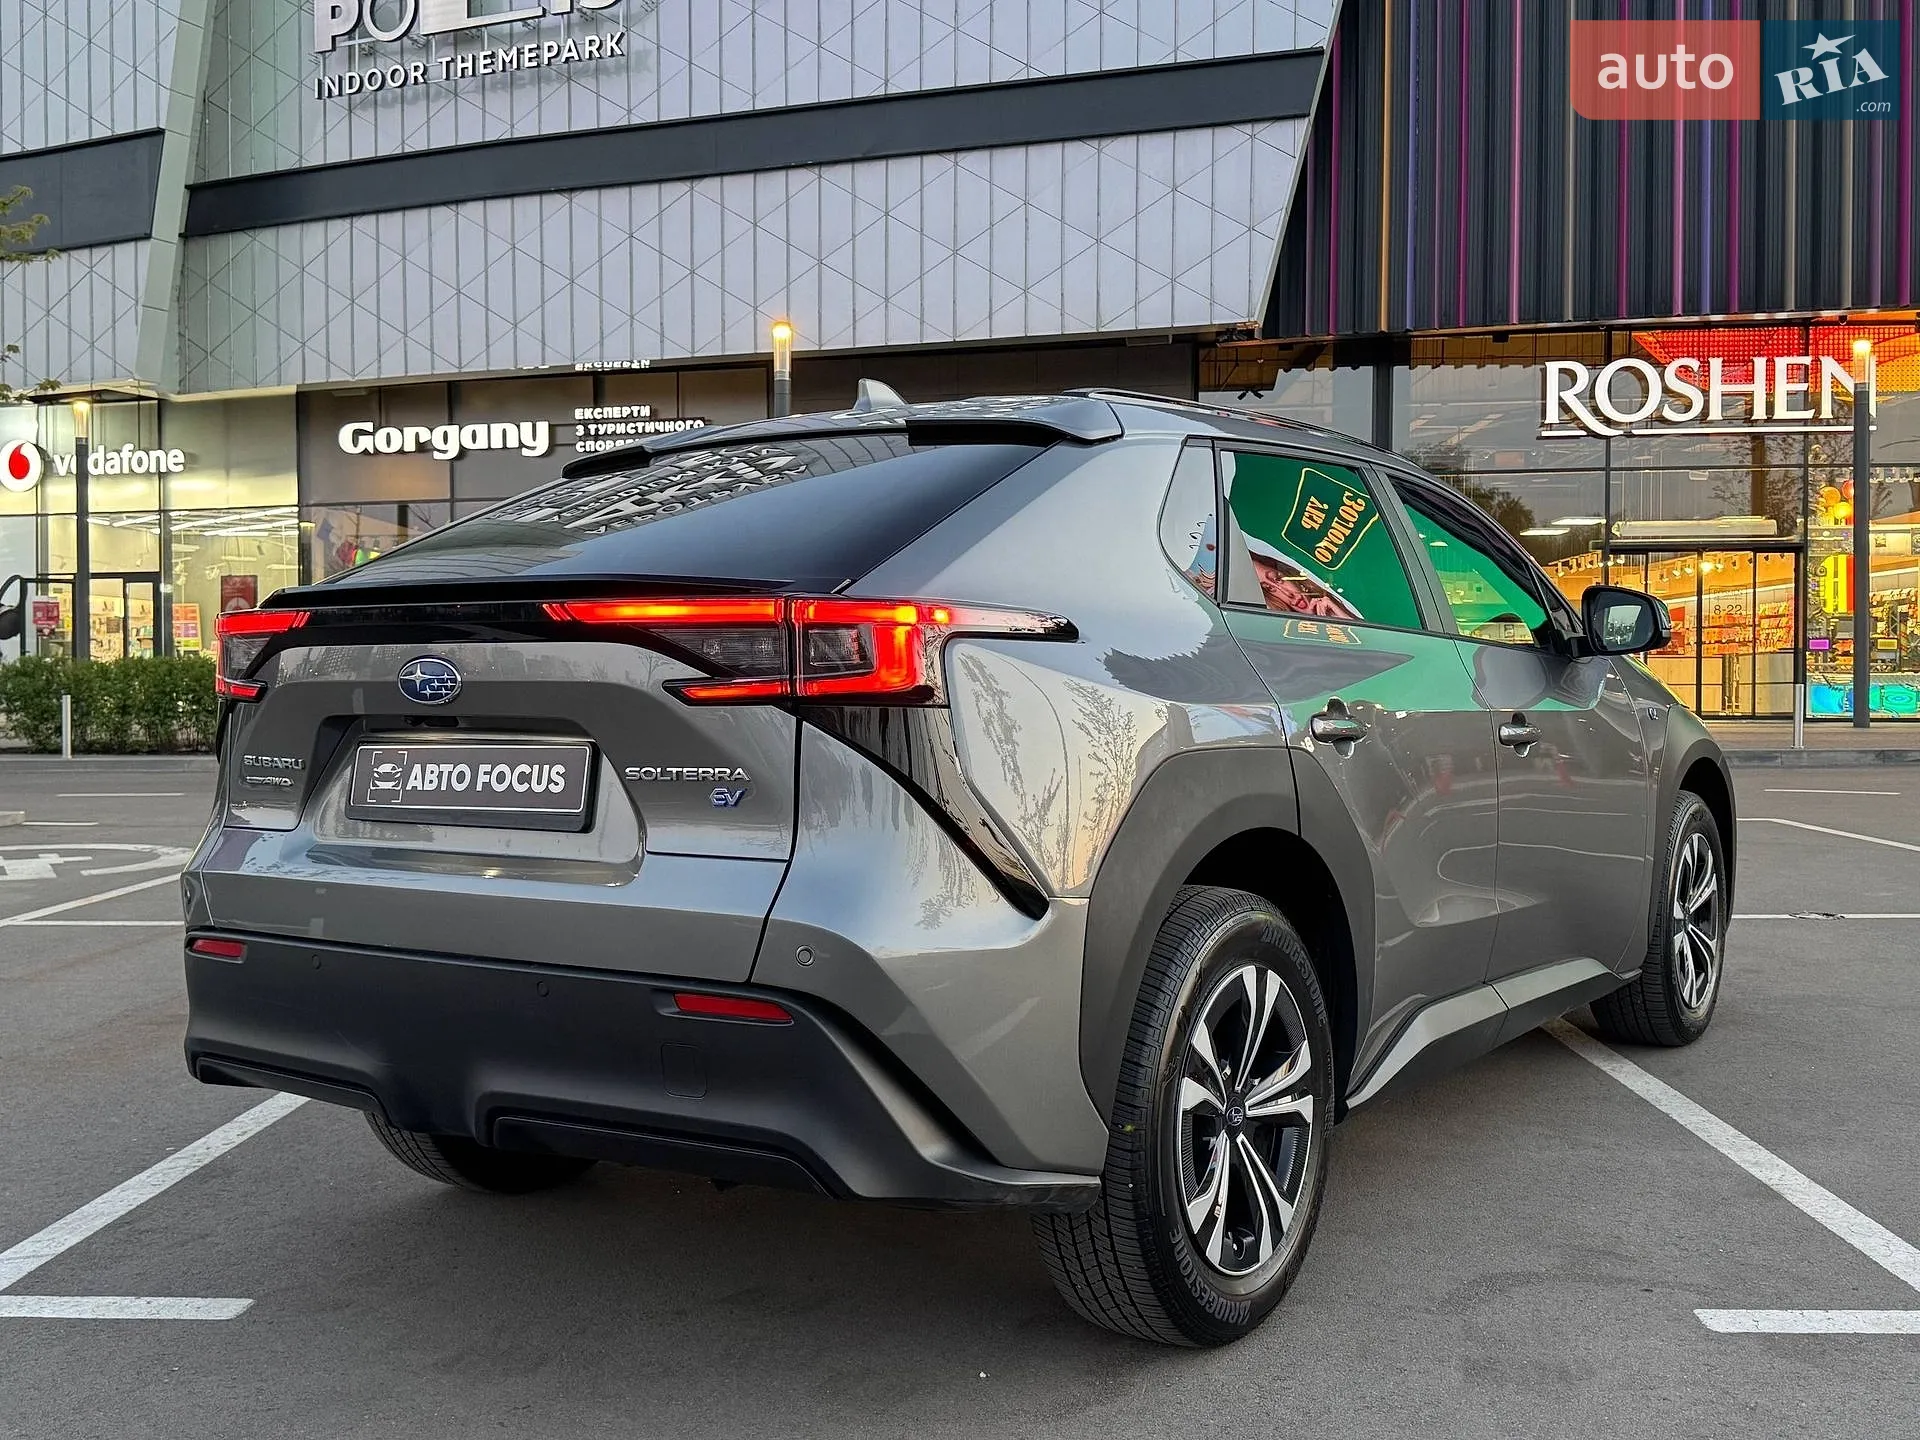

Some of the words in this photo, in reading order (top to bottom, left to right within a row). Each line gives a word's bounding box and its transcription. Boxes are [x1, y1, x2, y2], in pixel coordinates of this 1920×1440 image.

[314, 61, 426, 99] INDOOR
[438, 31, 626, 80] THEMEPARK
[1543, 355, 1877, 436] ROSHEN
[574, 405, 651, 420] ЕКСПЕРТИ
[588, 419, 705, 436] ТУРИСТИЧНОГО
[337, 420, 550, 460] Gorgany
[1713, 604, 1743, 616] 8-22
[243, 755, 303, 770] SUBARU
[407, 764, 471, 792] АВТО
[476, 764, 566, 794] FOCUS
[625, 767, 751, 781] SOLTERRA
[710, 788, 745, 806] EV
